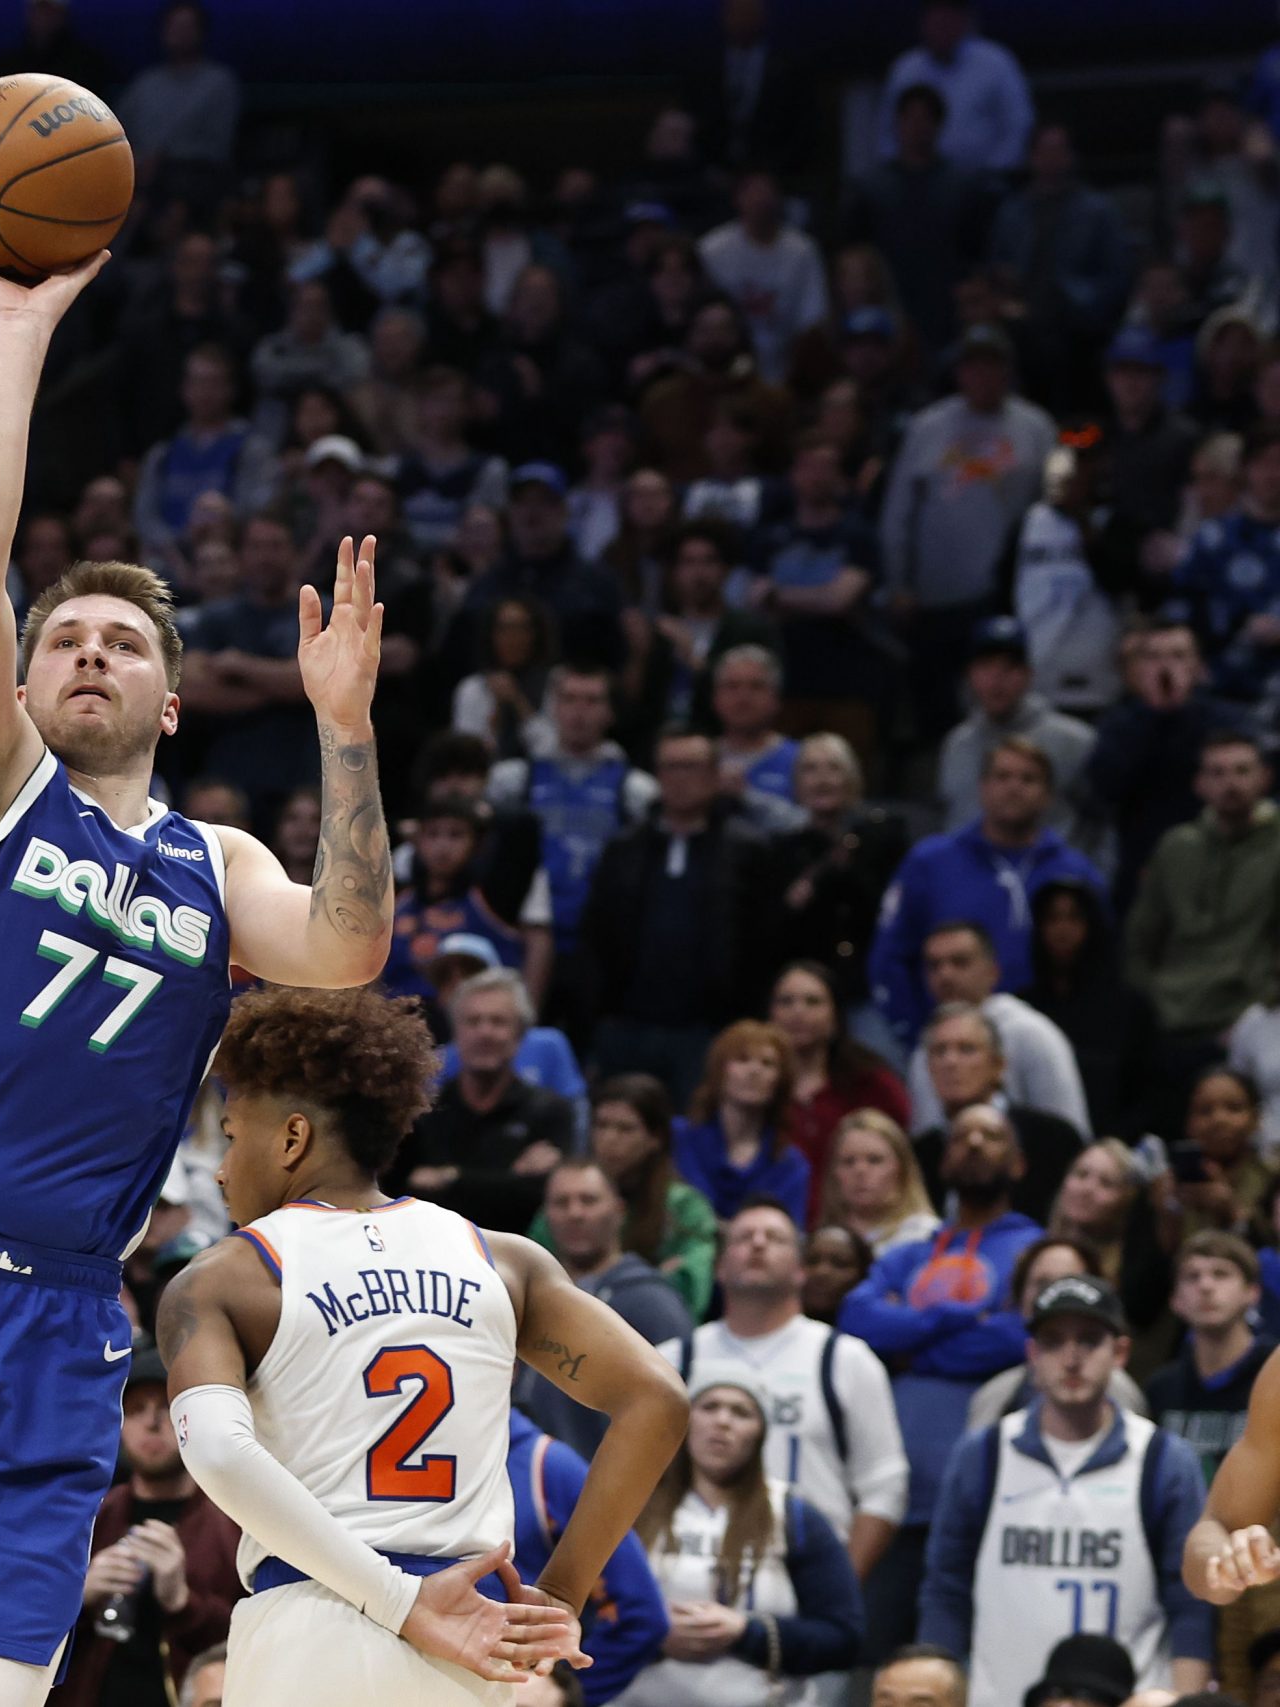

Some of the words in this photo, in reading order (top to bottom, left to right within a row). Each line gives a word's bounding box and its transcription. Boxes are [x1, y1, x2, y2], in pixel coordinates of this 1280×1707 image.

[156, 837, 205, 862] hime
[17, 928, 164, 1055] 77
[305, 1268, 481, 1337] McBRIDE
[362, 1343, 458, 1503] 2
[1000, 1526, 1123, 1569] DALLAS
[1055, 1578, 1119, 1640] 77
